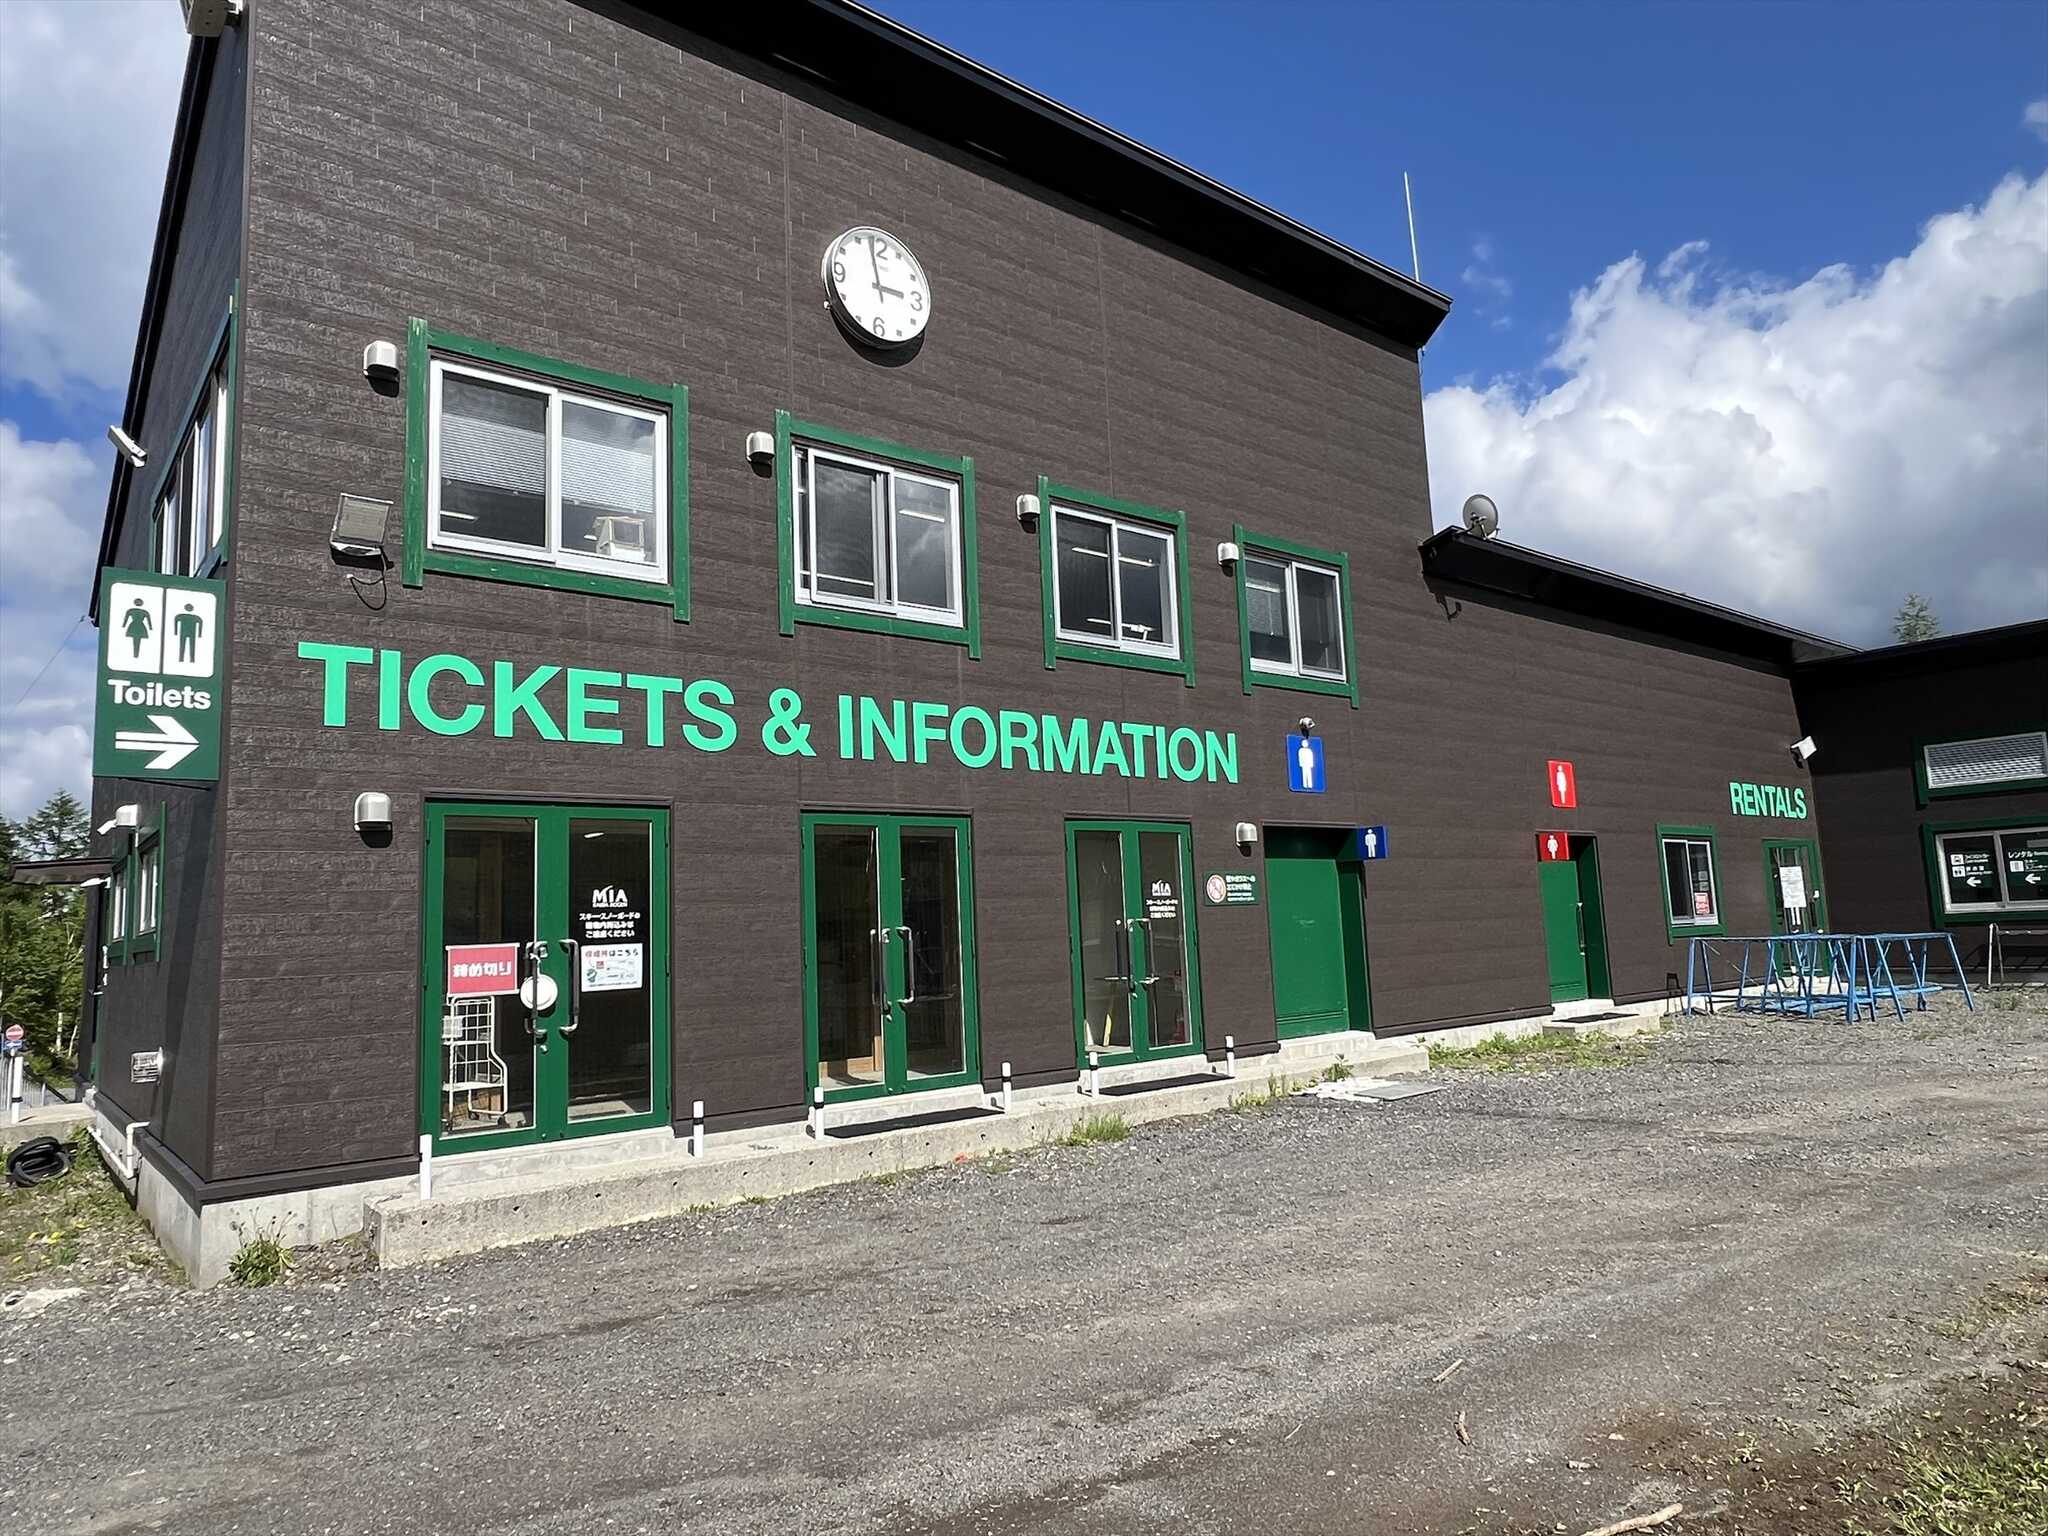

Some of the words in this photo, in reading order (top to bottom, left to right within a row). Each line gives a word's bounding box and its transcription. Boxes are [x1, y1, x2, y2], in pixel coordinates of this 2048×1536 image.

[833, 261, 846, 283] 9
[910, 290, 923, 311] 3
[872, 316, 886, 337] 6
[107, 679, 211, 710] Toilets
[298, 641, 738, 752] TICKETS
[761, 688, 817, 757] &
[838, 694, 1239, 784] INFORMATION
[1729, 782, 1807, 819] RENTALS
[592, 885, 629, 903] MIA
